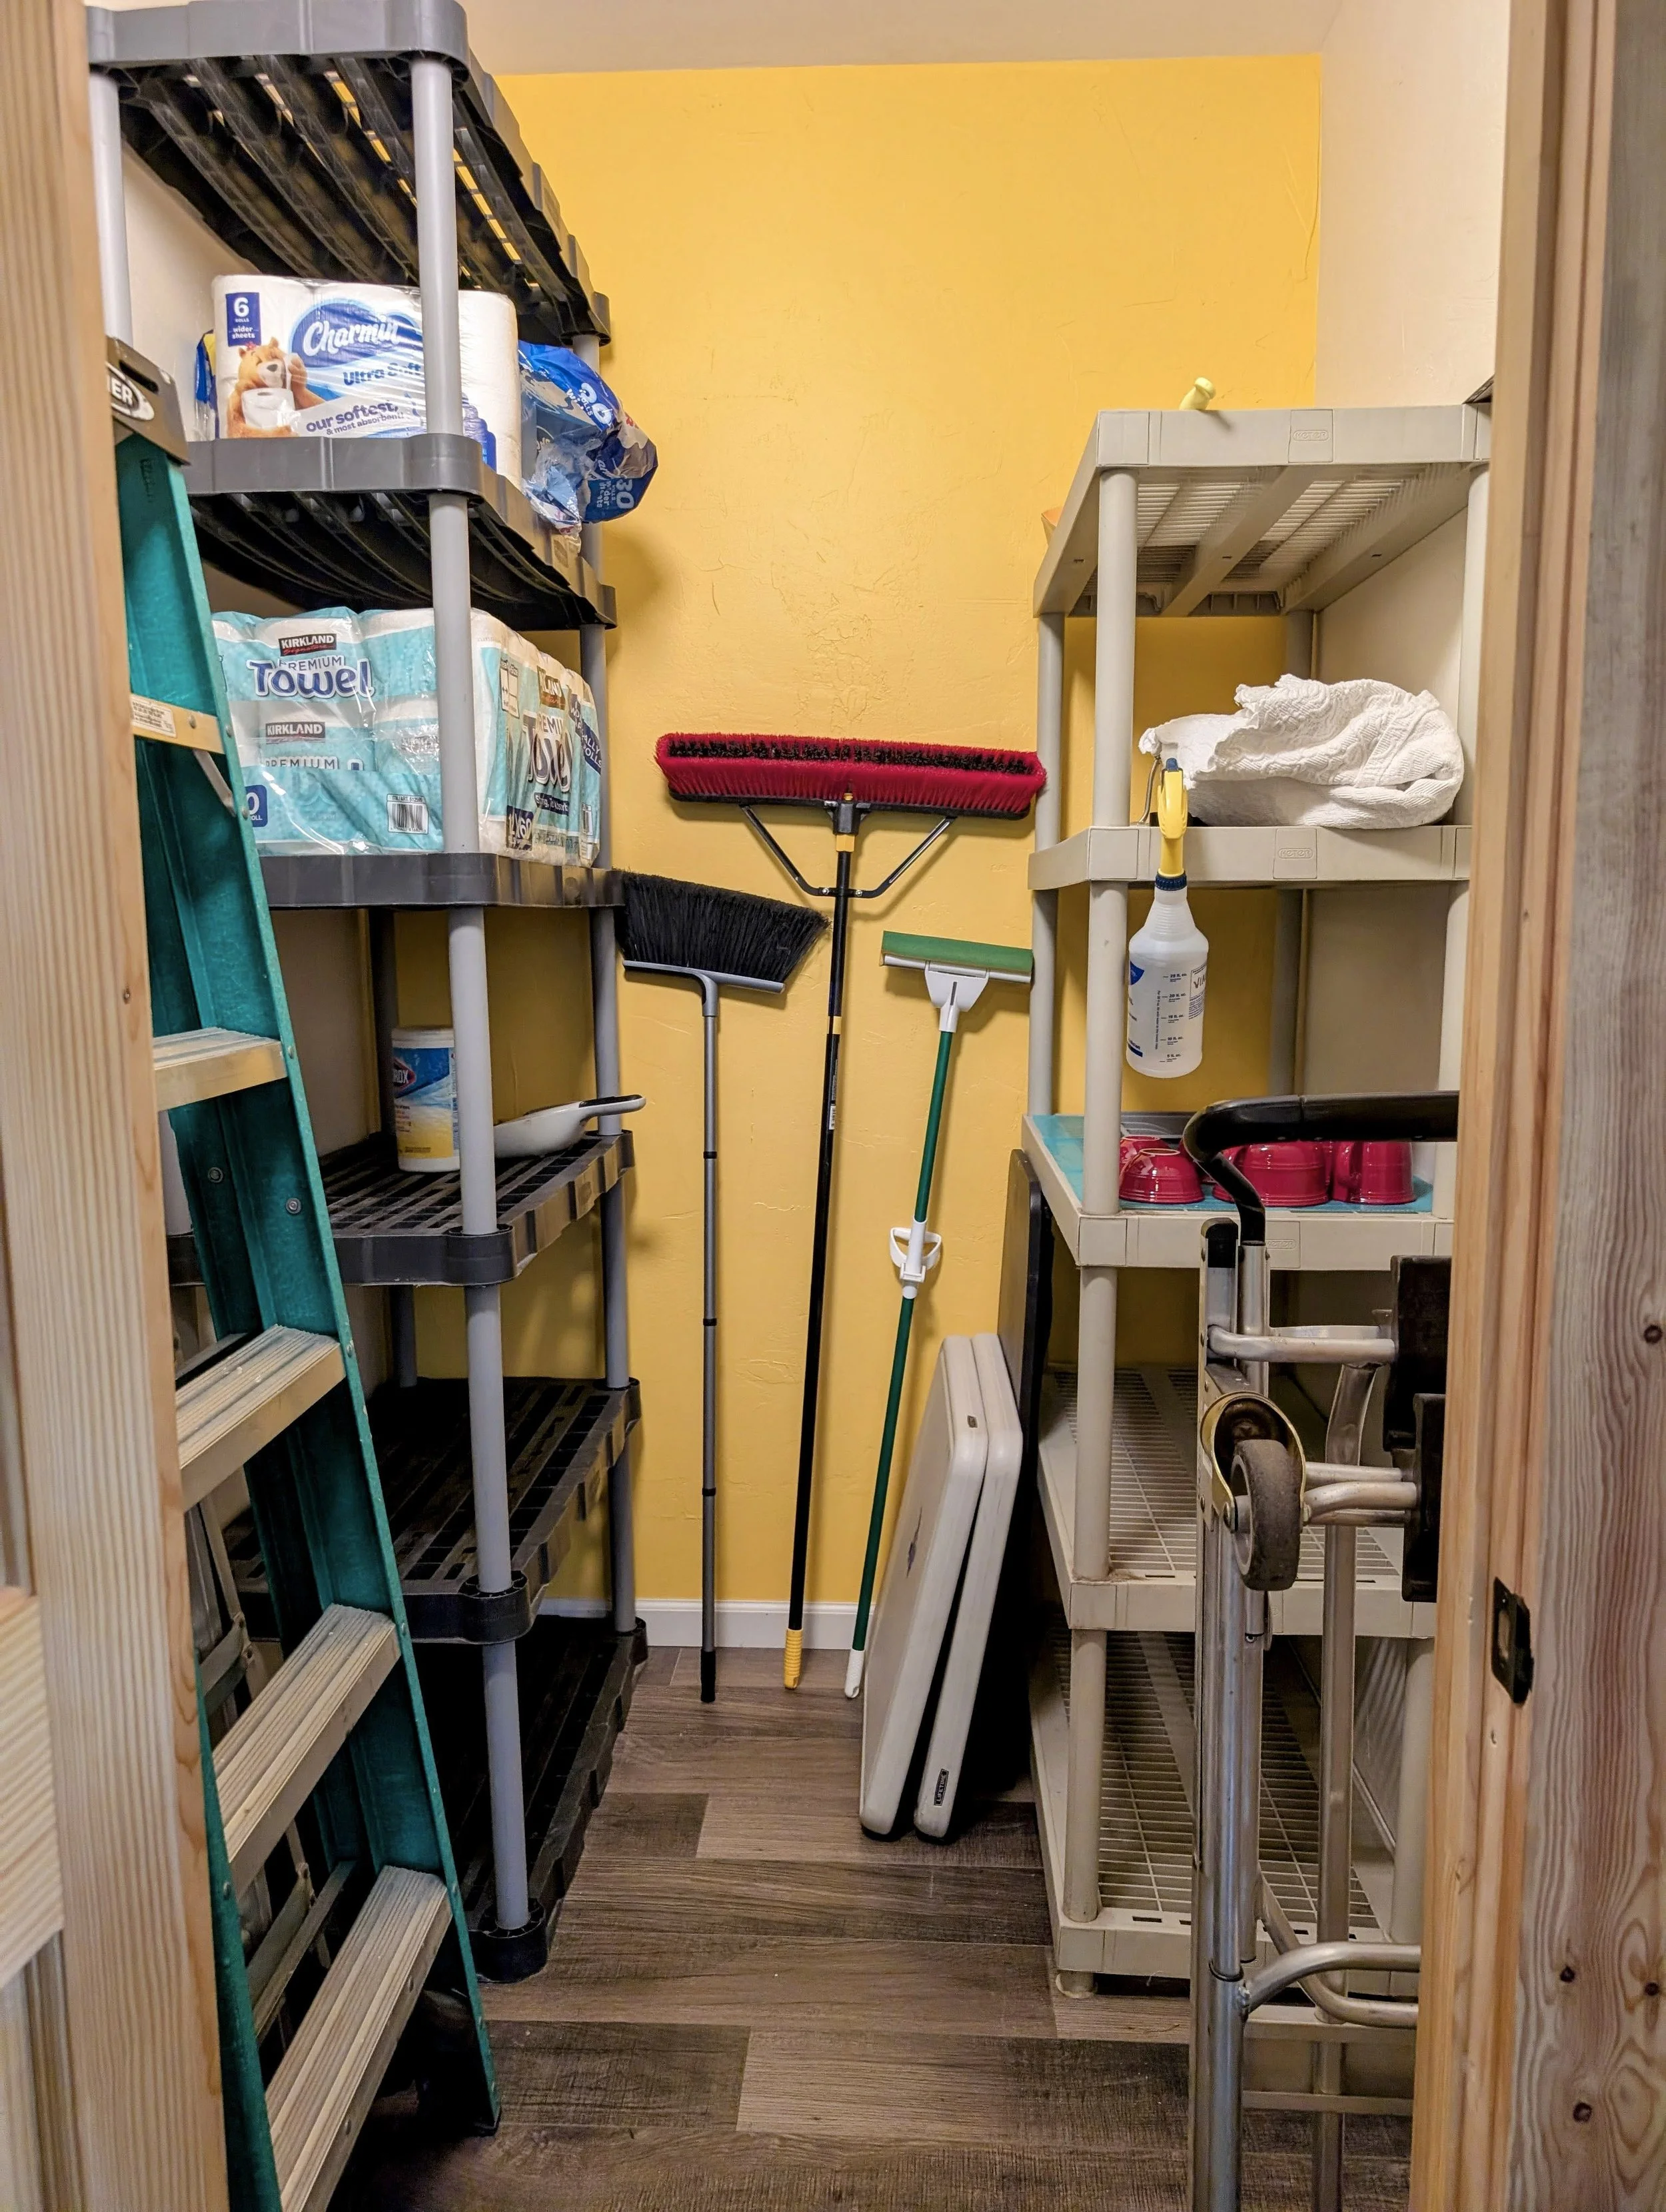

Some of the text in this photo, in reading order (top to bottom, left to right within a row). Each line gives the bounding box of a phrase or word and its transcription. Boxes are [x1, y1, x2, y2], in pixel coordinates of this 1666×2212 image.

[234, 297, 249, 317] 6
[303, 315, 400, 356] Charmin
[343, 362, 421, 386] Ultra Sft
[306, 402, 399, 432] our softest,
[334, 423, 357, 434] most
[281, 635, 335, 649] KIRKLAND
[279, 656, 342, 672] PREMIUM
[249, 660, 369, 696] Towel
[267, 724, 323, 736] KIRKLAND
